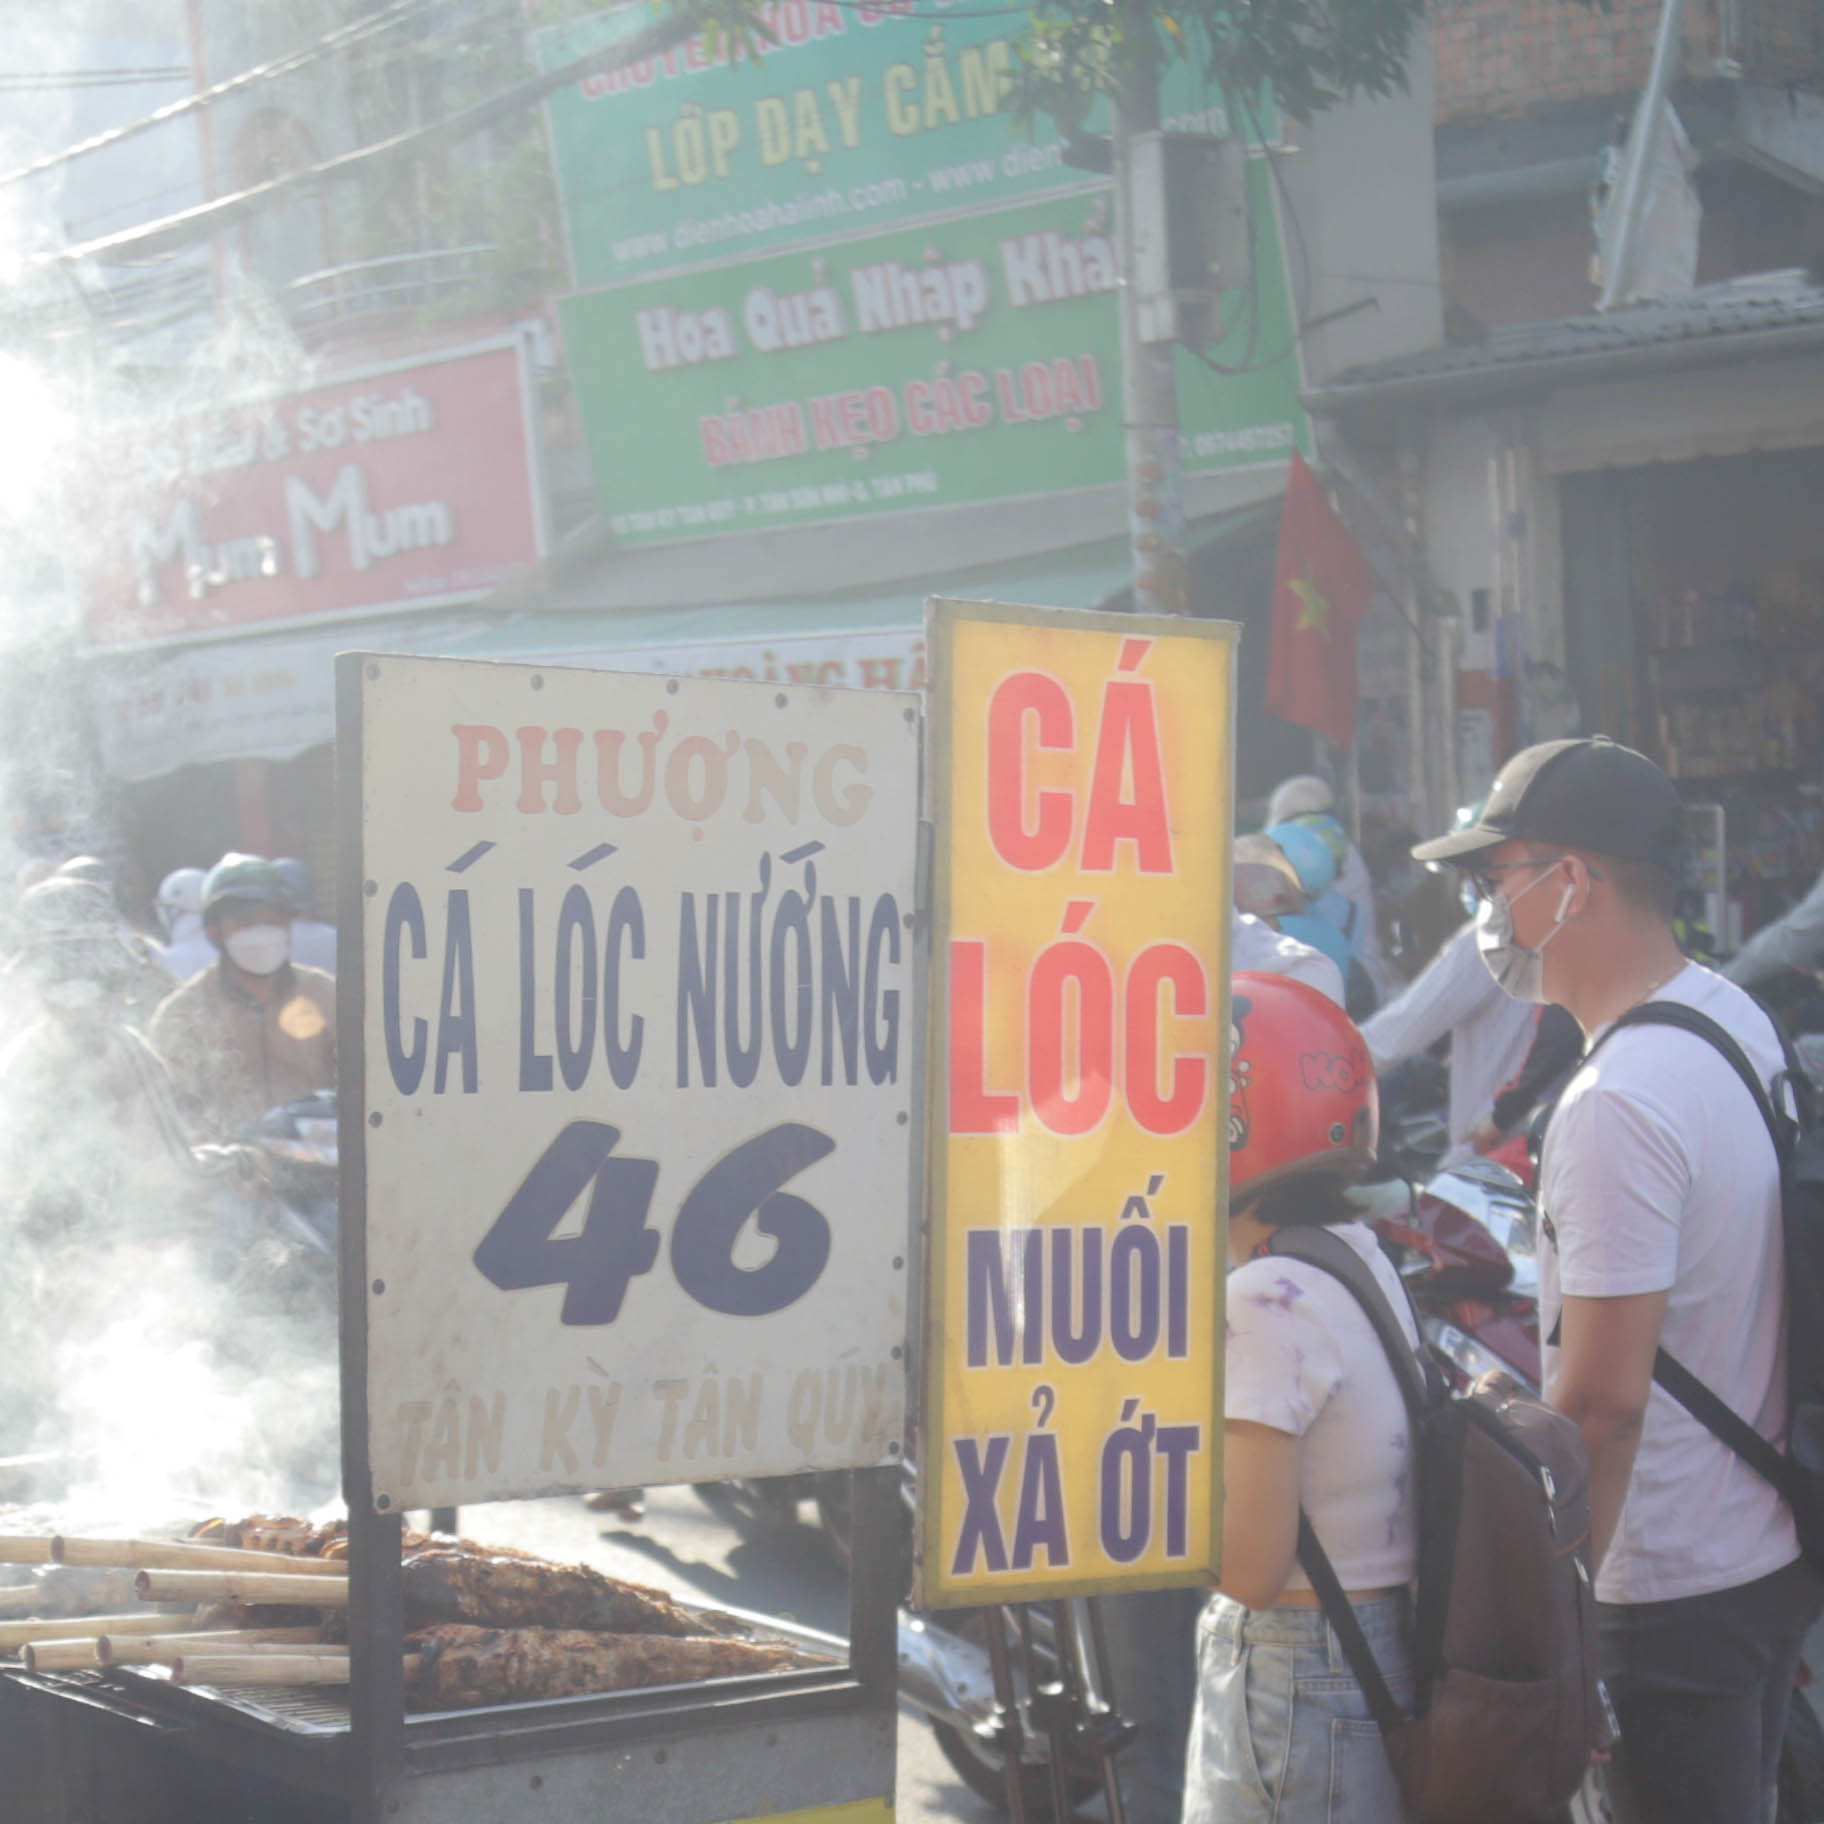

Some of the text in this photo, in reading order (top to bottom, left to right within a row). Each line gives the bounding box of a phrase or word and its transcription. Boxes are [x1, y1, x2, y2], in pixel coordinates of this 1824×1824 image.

[754, 75, 862, 174] DẠY
[635, 305, 738, 372] Hoa
[743, 256, 848, 353] Quả
[905, 360, 991, 437] CÁC
[995, 353, 1105, 433] LOẠI
[283, 462, 453, 581] Mum
[450, 708, 875, 842] PHƯỢNG
[986, 638, 1174, 875] CÁ
[381, 838, 902, 1096] CÁ LÓC NƯỚNG
[946, 900, 1207, 1138] LÓC
[472, 1119, 837, 1327] 46
[964, 1174, 1190, 1368] MUỐI
[397, 1378, 509, 1488] TÂN
[538, 1355, 623, 1475] KỲ
[652, 1361, 764, 1463] TÂN
[951, 1384, 1201, 1575] XẢ ỚT
